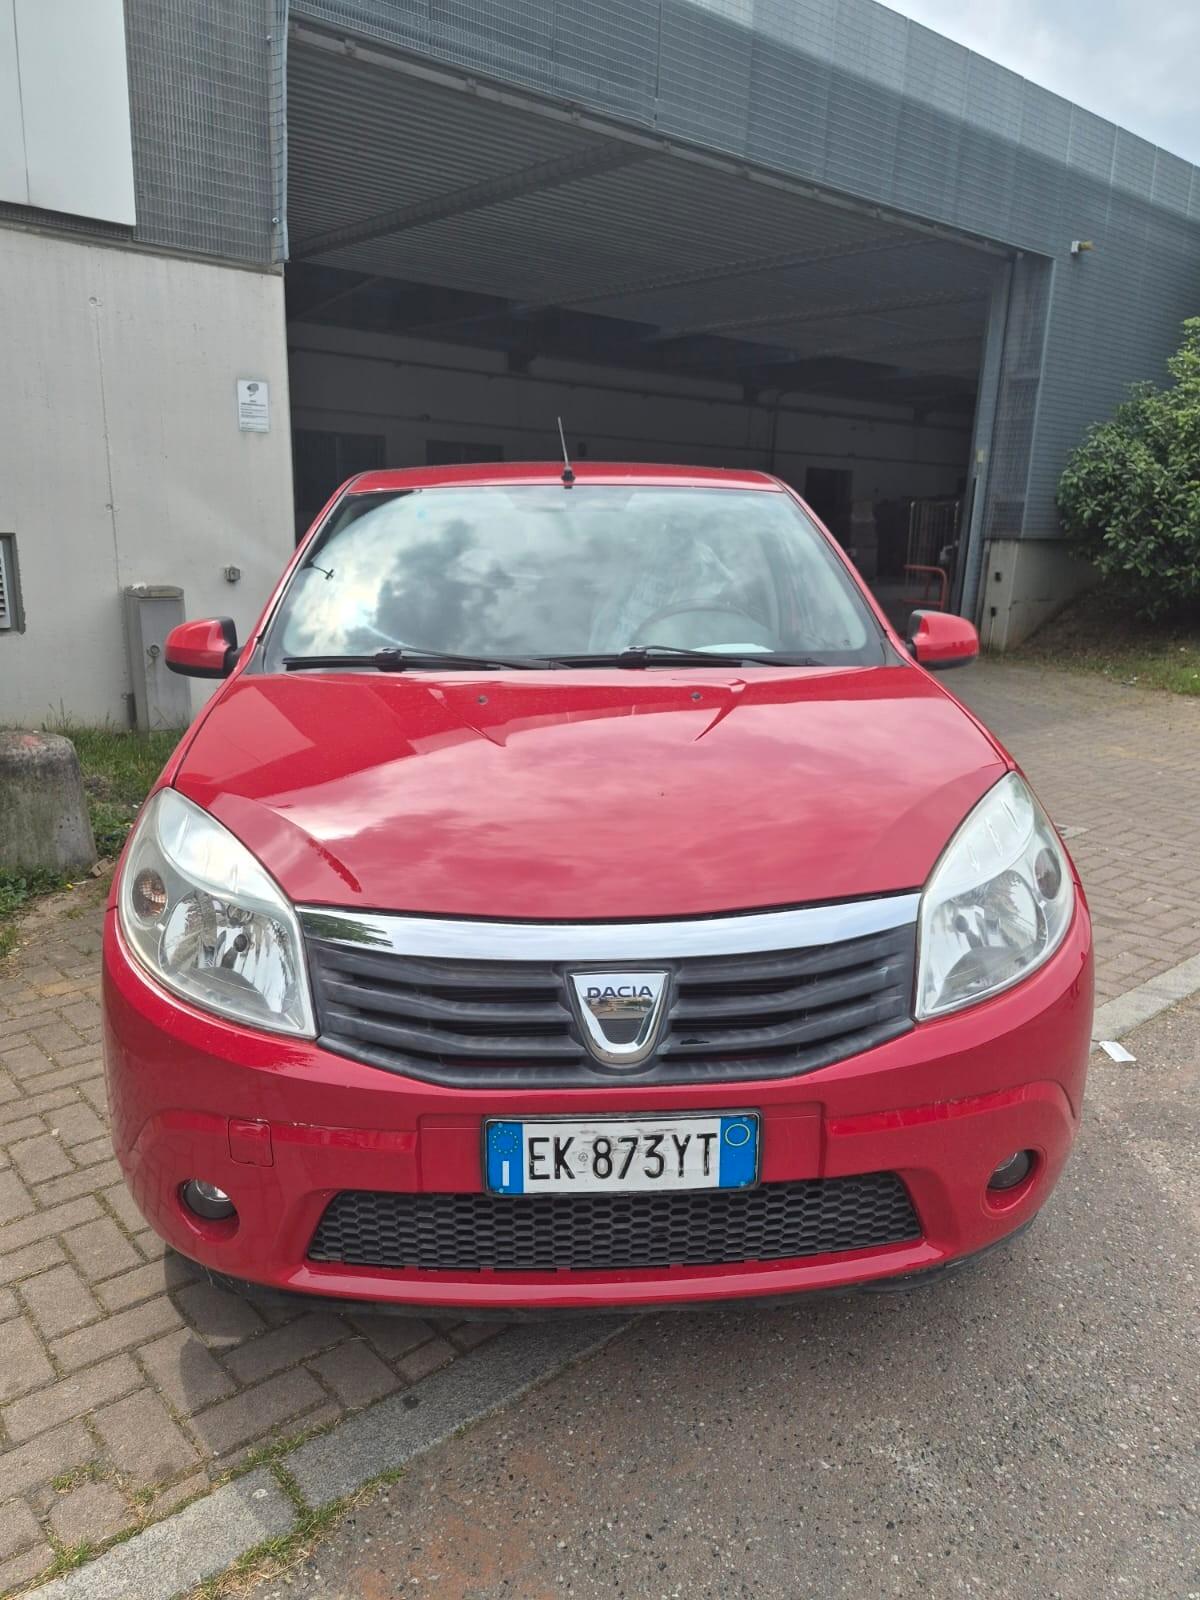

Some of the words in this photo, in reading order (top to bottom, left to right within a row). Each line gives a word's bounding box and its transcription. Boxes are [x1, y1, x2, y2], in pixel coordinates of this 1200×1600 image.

[587, 986, 653, 998] DACIA
[528, 1136, 575, 1180] EK
[502, 1160, 509, 1186] I
